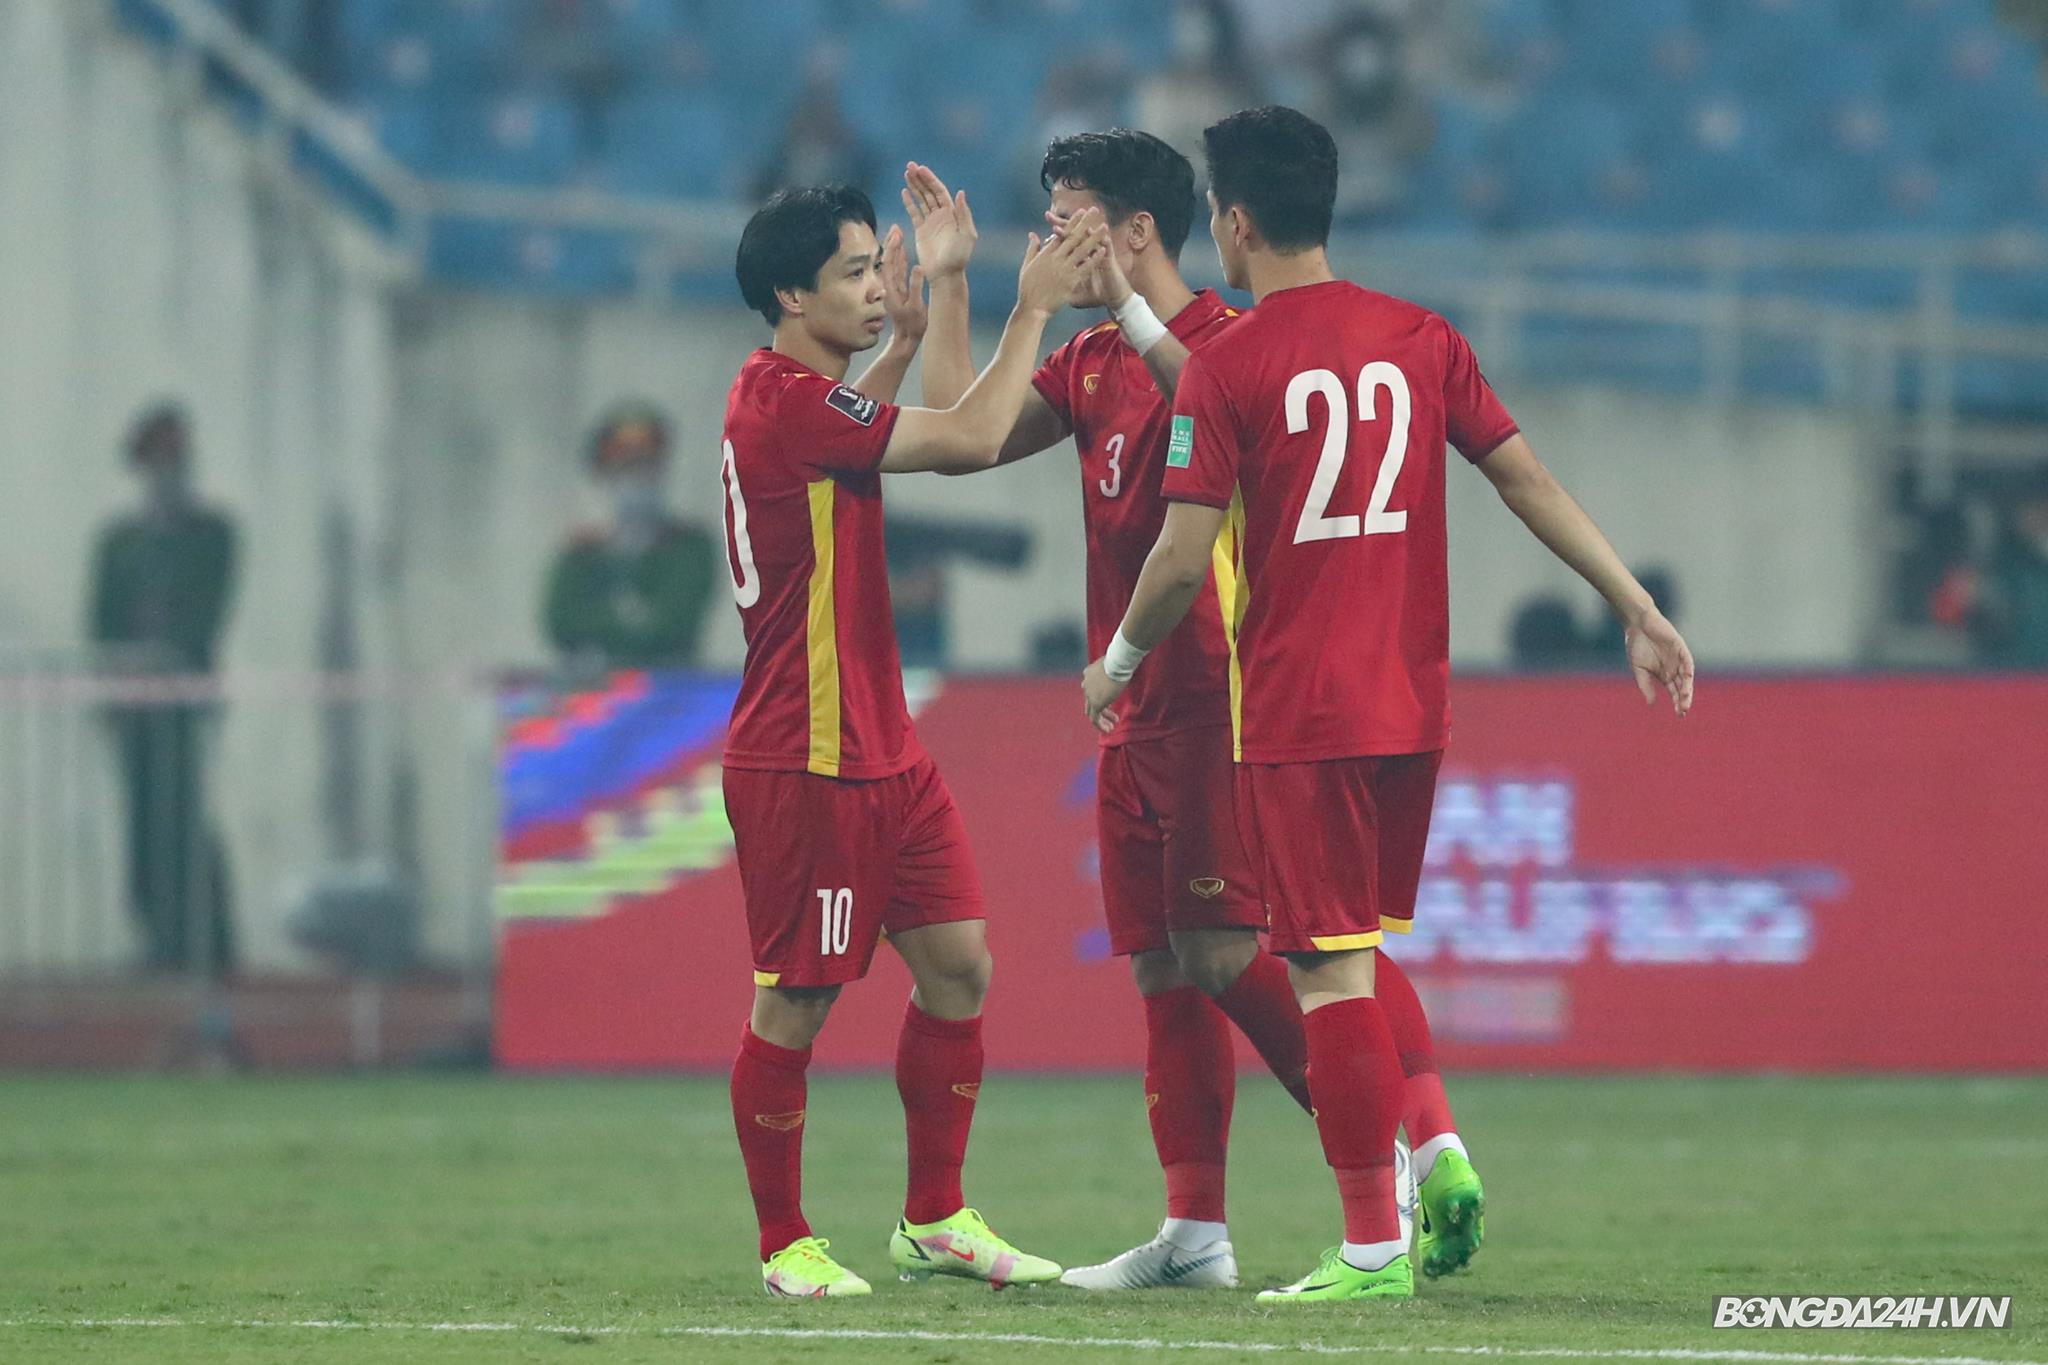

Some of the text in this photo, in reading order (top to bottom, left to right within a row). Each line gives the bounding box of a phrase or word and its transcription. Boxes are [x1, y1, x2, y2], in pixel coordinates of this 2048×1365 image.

[1100, 434, 1125, 498] 3
[1285, 361, 1412, 544] 22
[817, 888, 853, 955] 10
